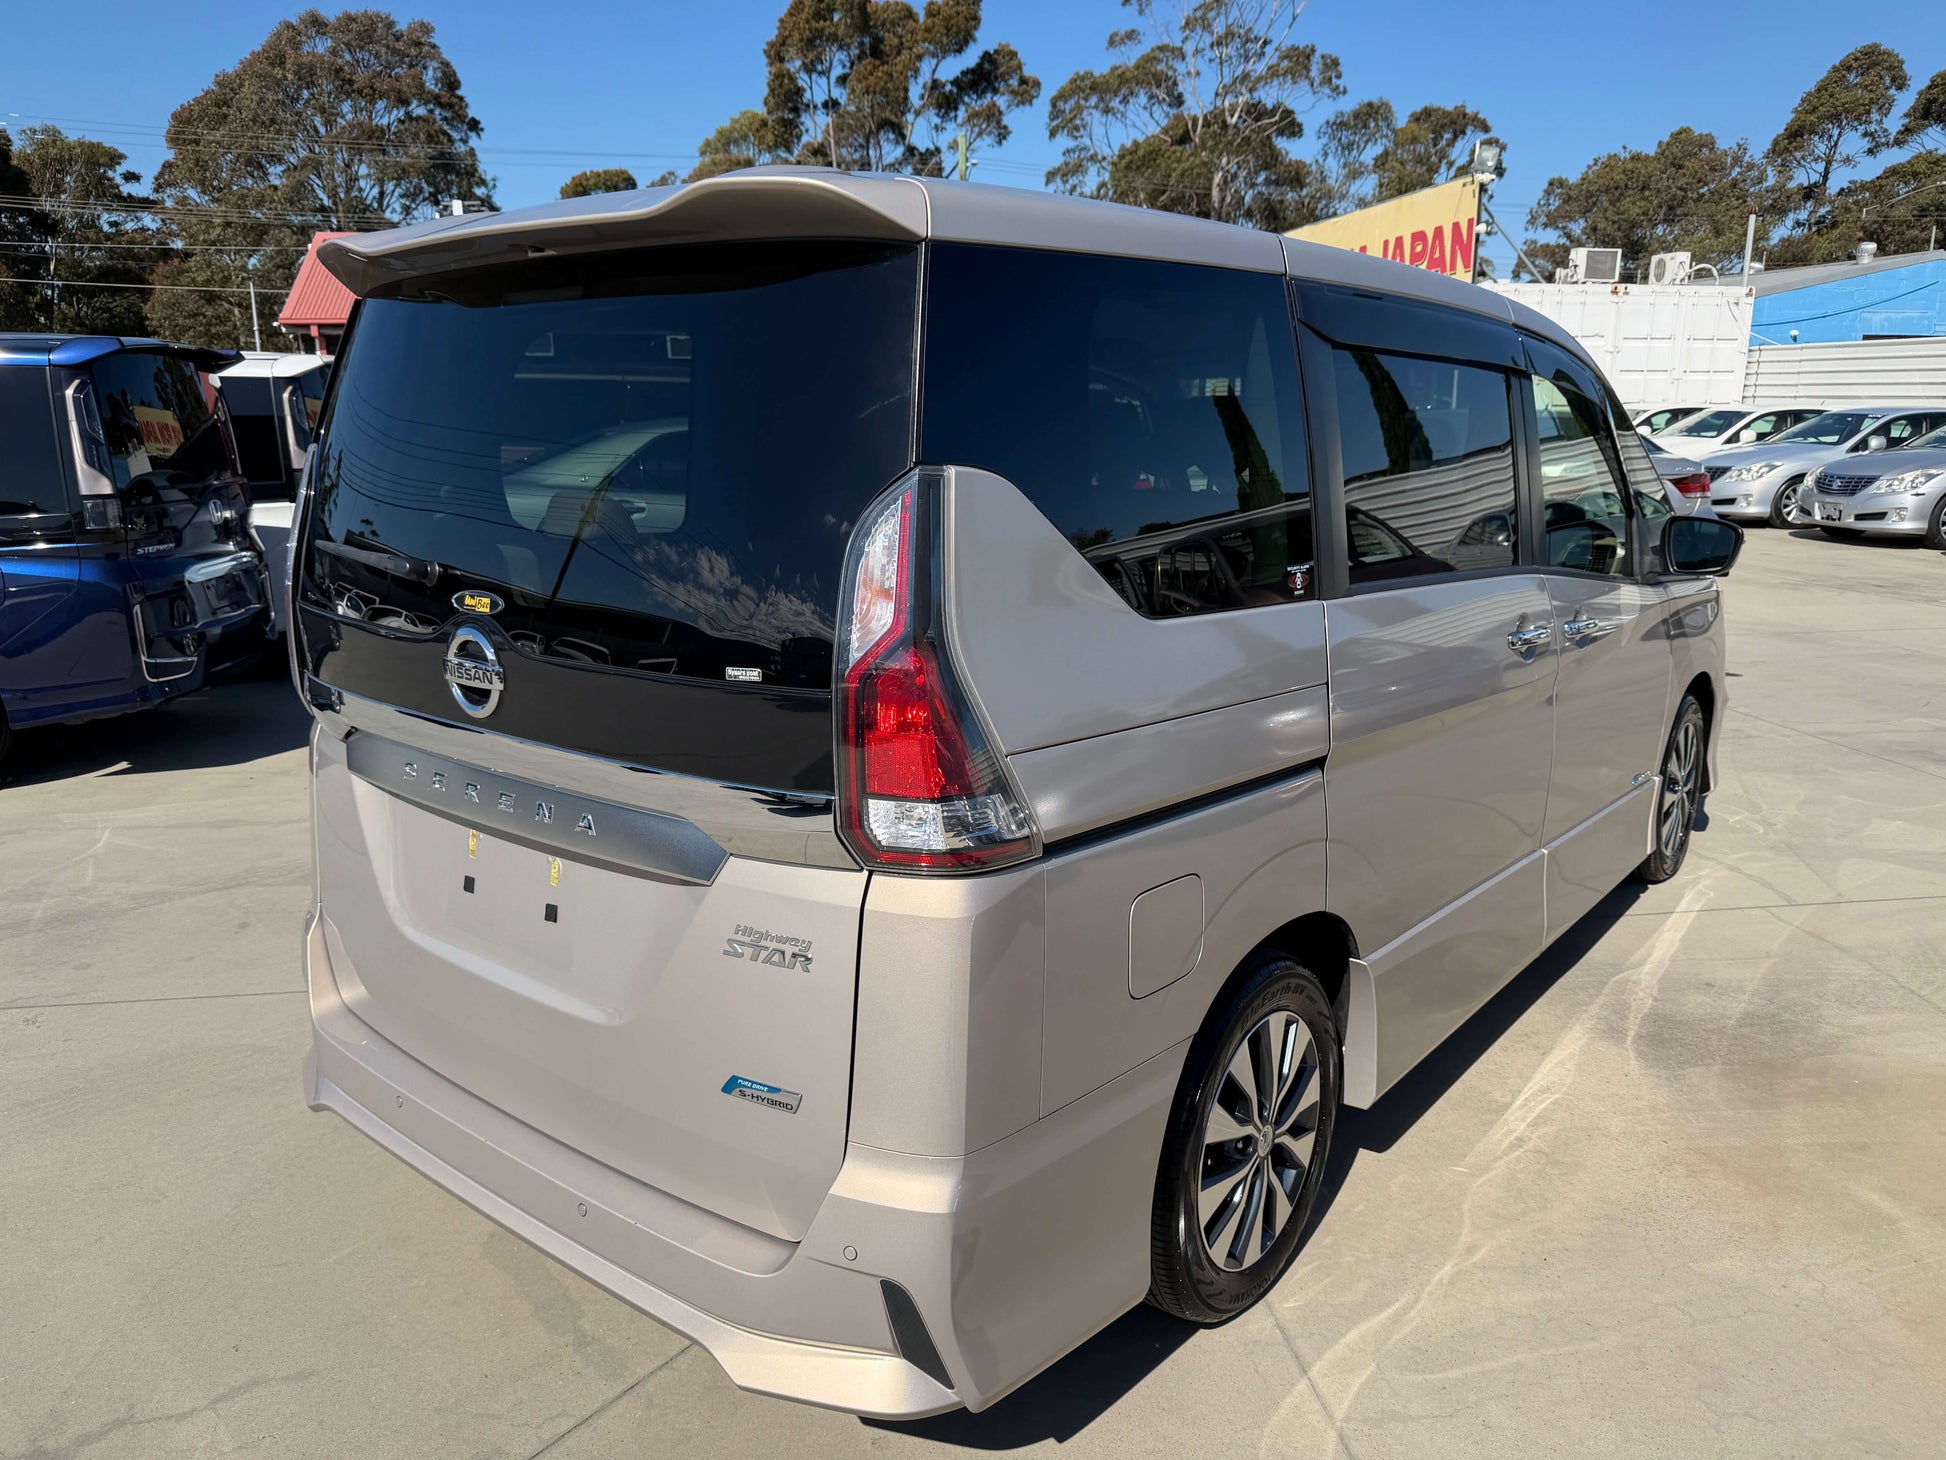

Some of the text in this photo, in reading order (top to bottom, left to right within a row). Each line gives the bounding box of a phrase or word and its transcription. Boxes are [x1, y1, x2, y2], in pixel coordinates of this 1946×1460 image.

[446, 664, 493, 685] NISSAN
[403, 762, 597, 836] SERENA
[734, 924, 813, 953] Highway
[722, 938, 813, 973] STAR
[737, 1079, 769, 1092] PURE DRIVE
[738, 1089, 794, 1111] S-HYBRID
